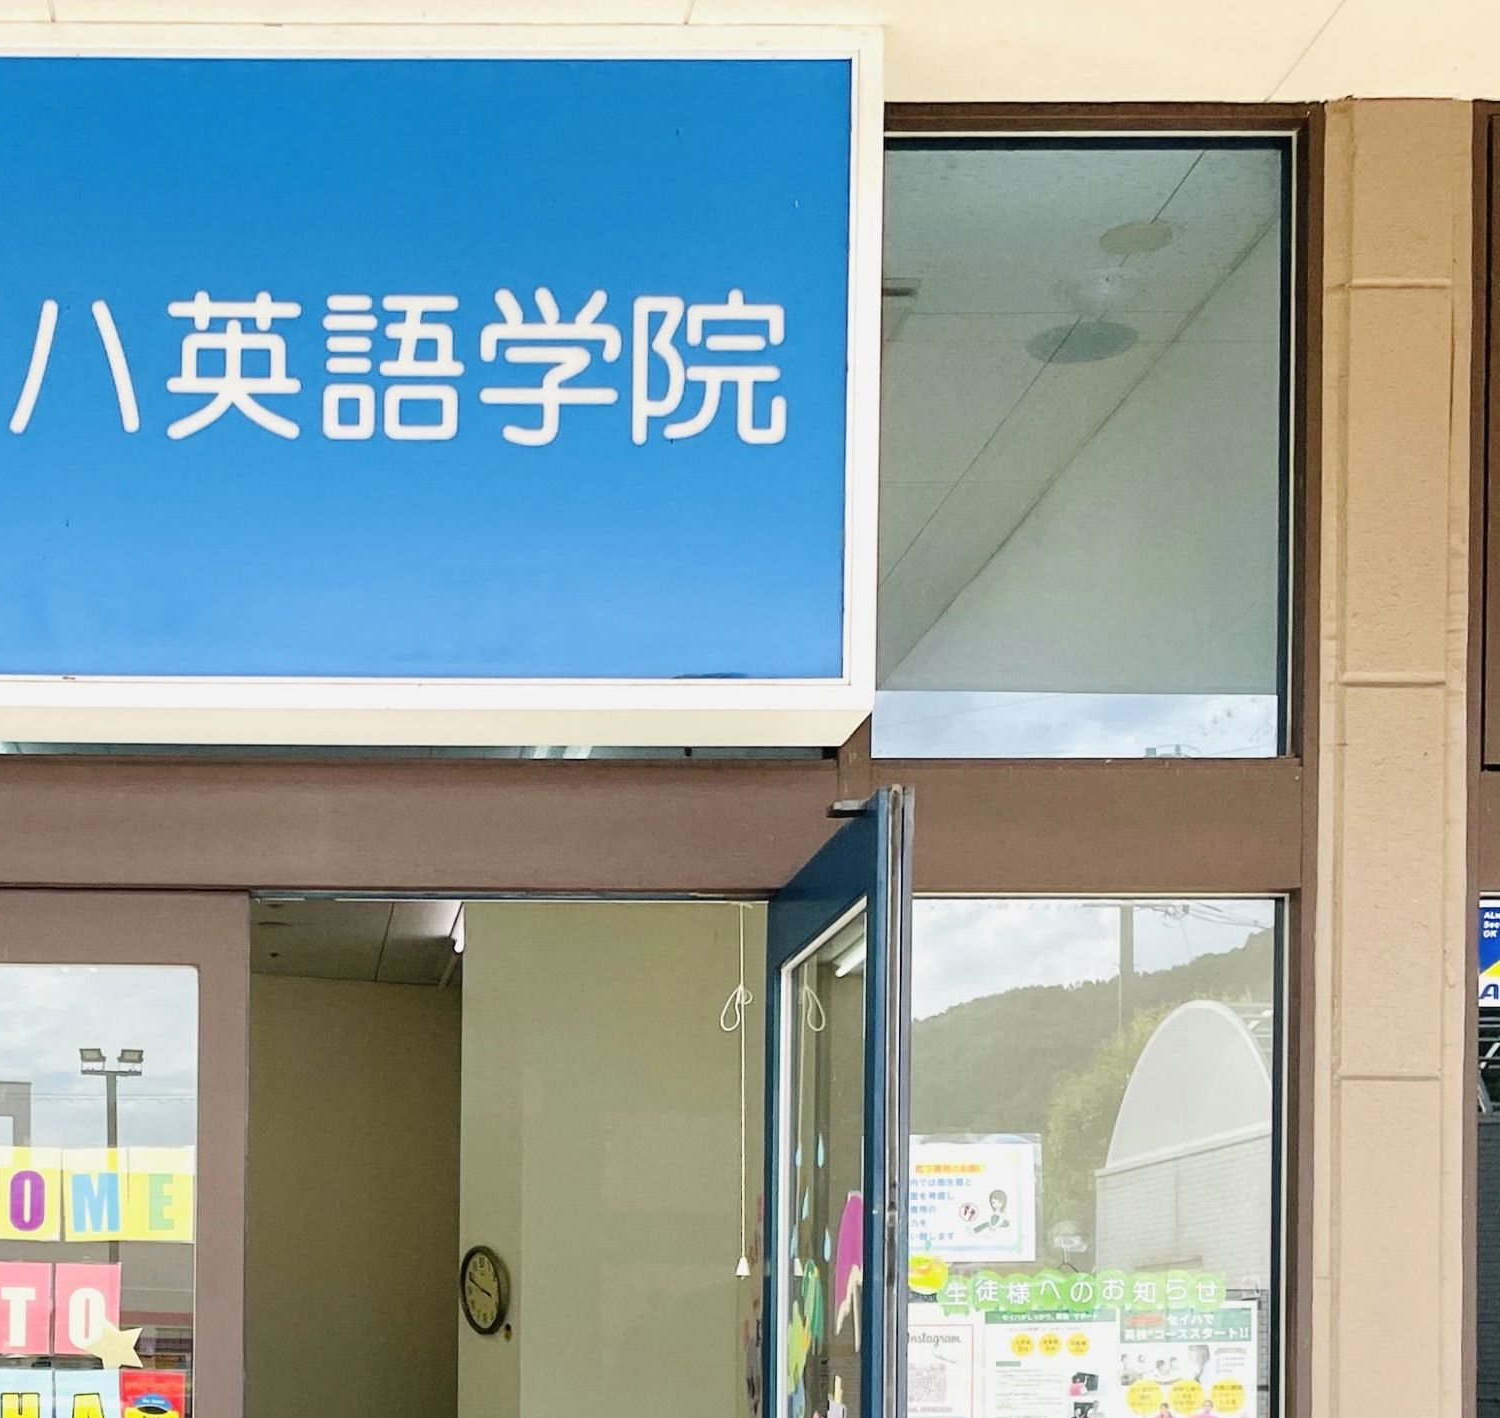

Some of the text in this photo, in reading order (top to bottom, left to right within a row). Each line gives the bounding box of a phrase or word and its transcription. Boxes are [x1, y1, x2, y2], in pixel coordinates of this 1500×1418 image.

[944, 1277, 1219, 1307] 生徒様へのお知らせ
[0, 1287, 107, 1350] TO
